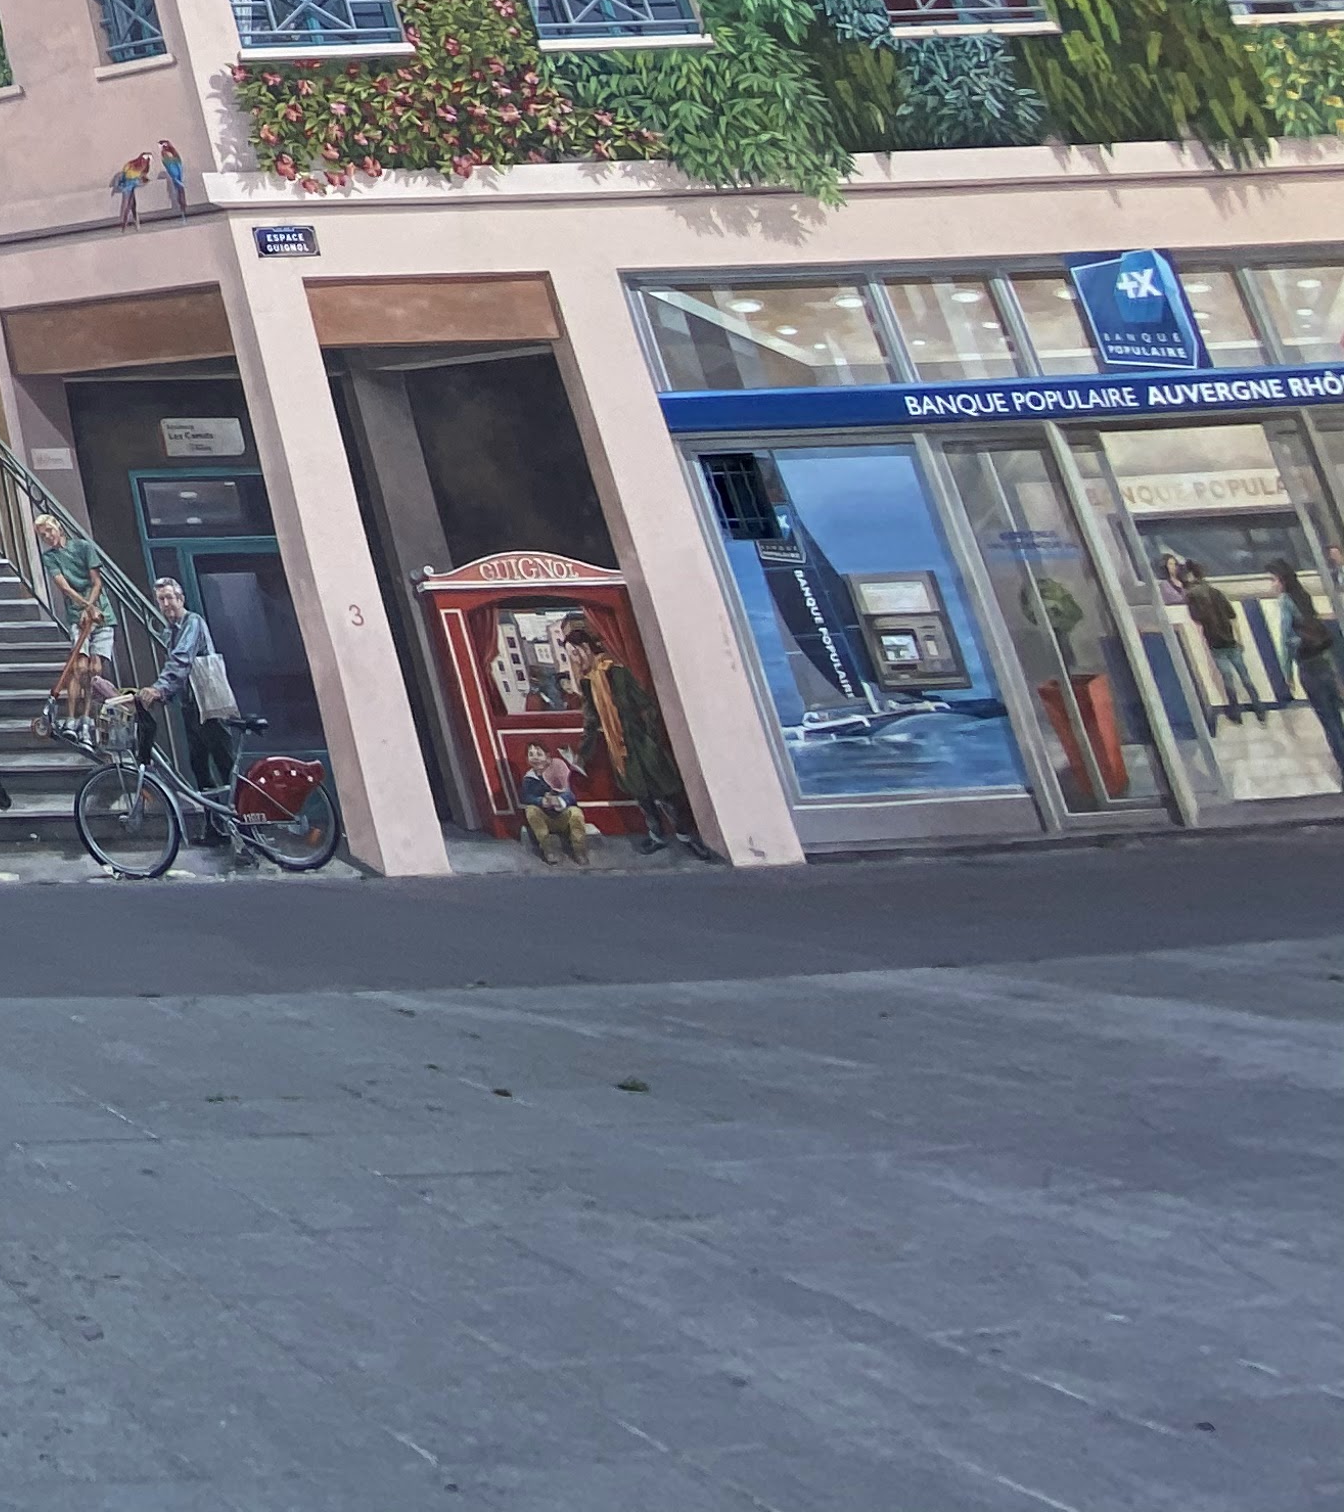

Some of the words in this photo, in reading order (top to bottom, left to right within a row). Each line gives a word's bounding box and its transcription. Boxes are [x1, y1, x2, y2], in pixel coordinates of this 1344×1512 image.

[266, 233, 305, 242] ESPACE
[266, 243, 310, 252] GUIGNOL
[1103, 332, 1182, 343] BANQUE
[1107, 345, 1188, 358] POPULAIRE
[904, 393, 1007, 417] BANQUE
[1012, 386, 1140, 413] POPULAIRE
[1147, 377, 1286, 407] AUVERGNE
[1287, 370, 1344, 397] RHÔ
[479, 557, 579, 581] GUIGNOL
[793, 569, 825, 624] BANQUE
[349, 604, 364, 627] 3
